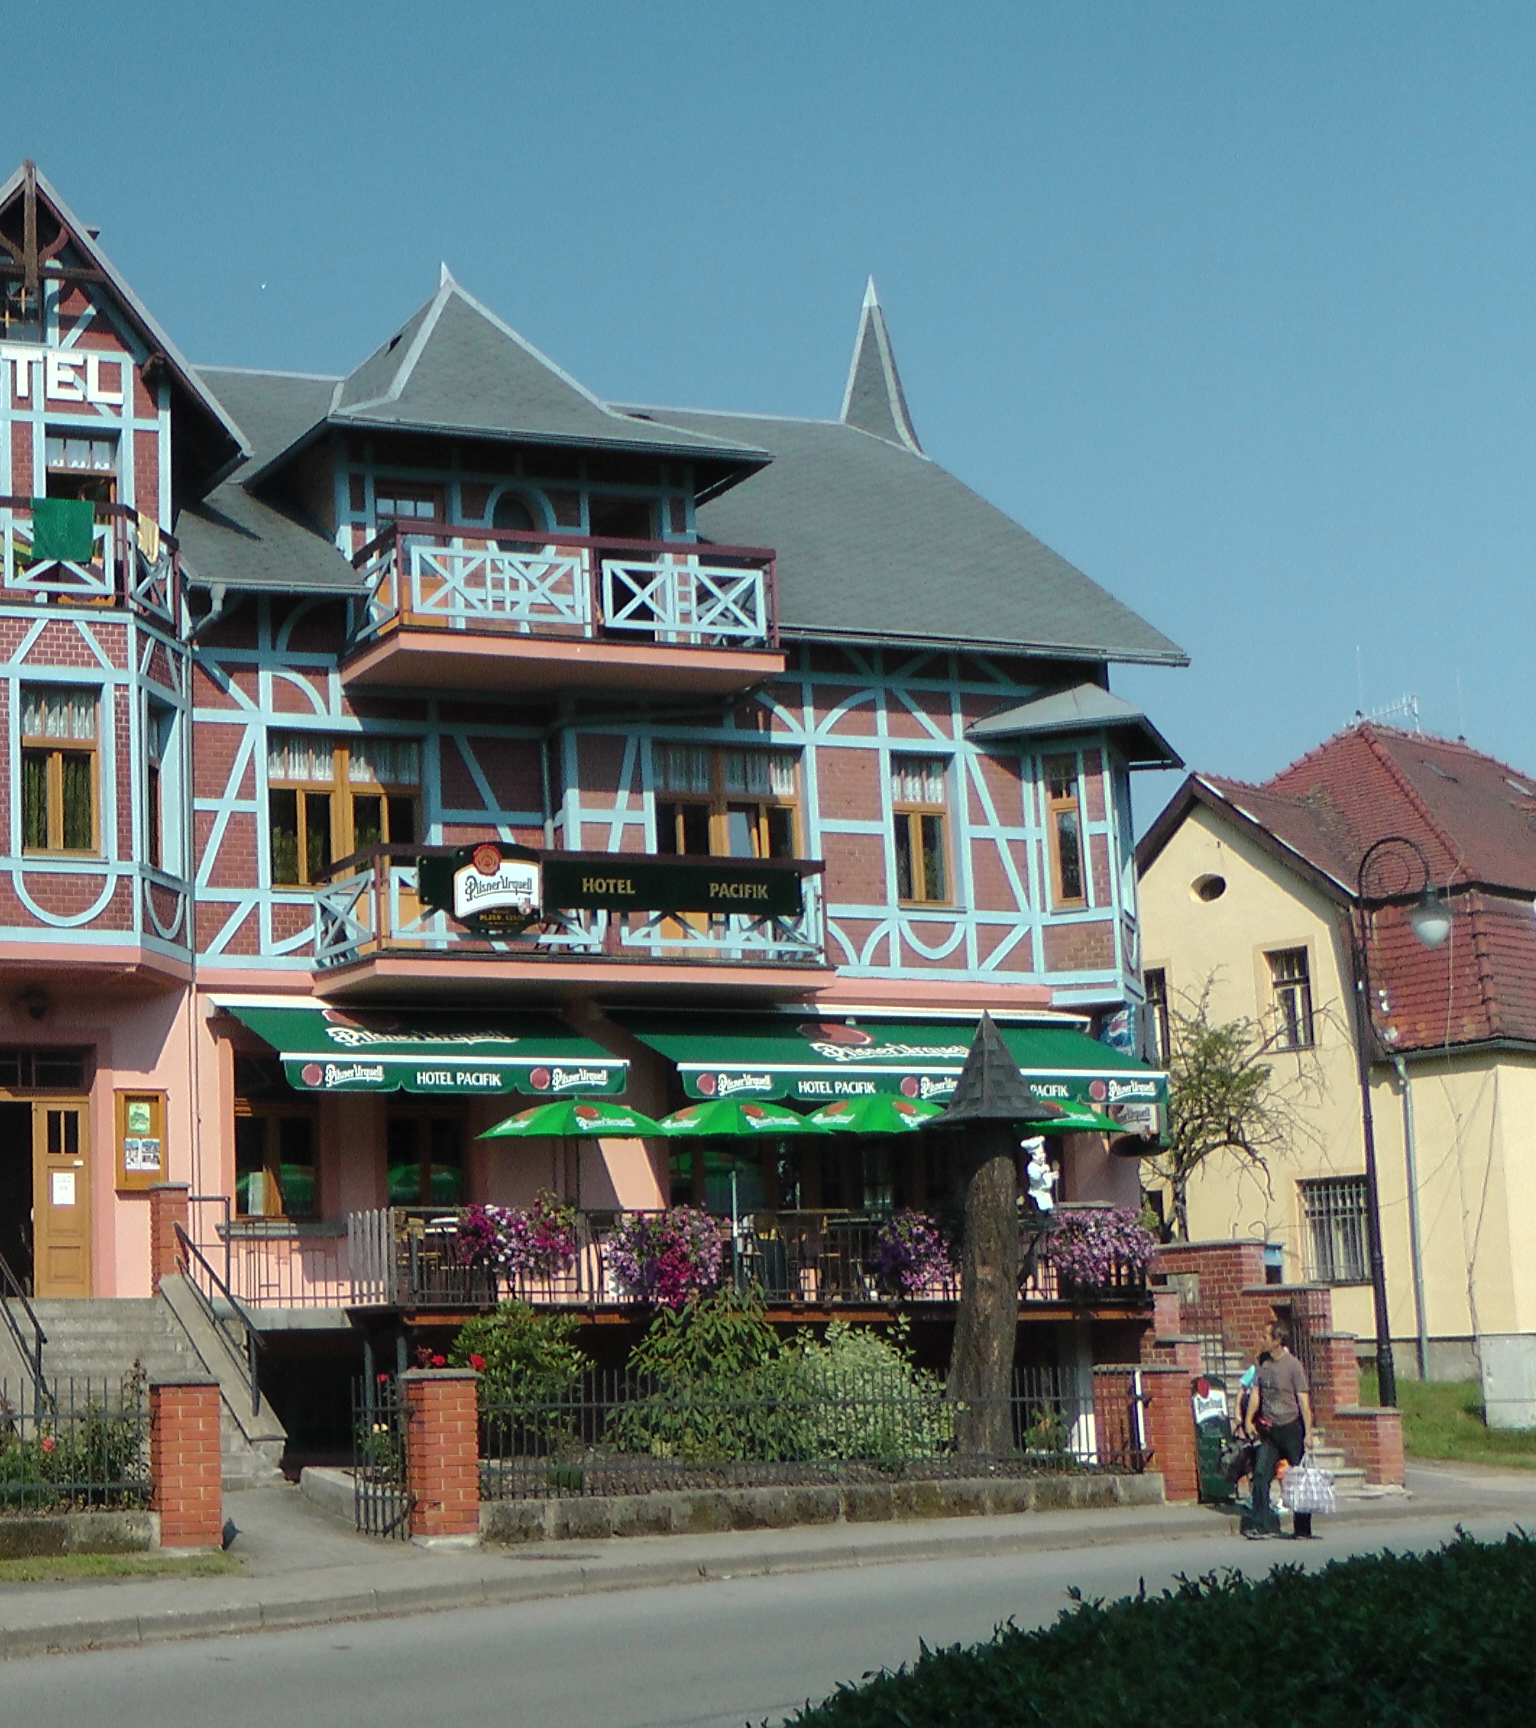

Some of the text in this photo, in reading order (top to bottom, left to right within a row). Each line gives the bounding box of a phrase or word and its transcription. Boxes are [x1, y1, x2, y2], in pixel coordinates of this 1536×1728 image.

[465, 874, 532, 902] Pilsner Urquell
[582, 878, 768, 899] HOTEL PACIFIK
[325, 1063, 384, 1088] Pilsner Urquell
[417, 1072, 502, 1086] HOTEL PACIFIK
[552, 1068, 608, 1091] Pilsner Urquell
[718, 1073, 744, 1096] Pilsner
[798, 1081, 876, 1094] HOTEL PACIFIK
